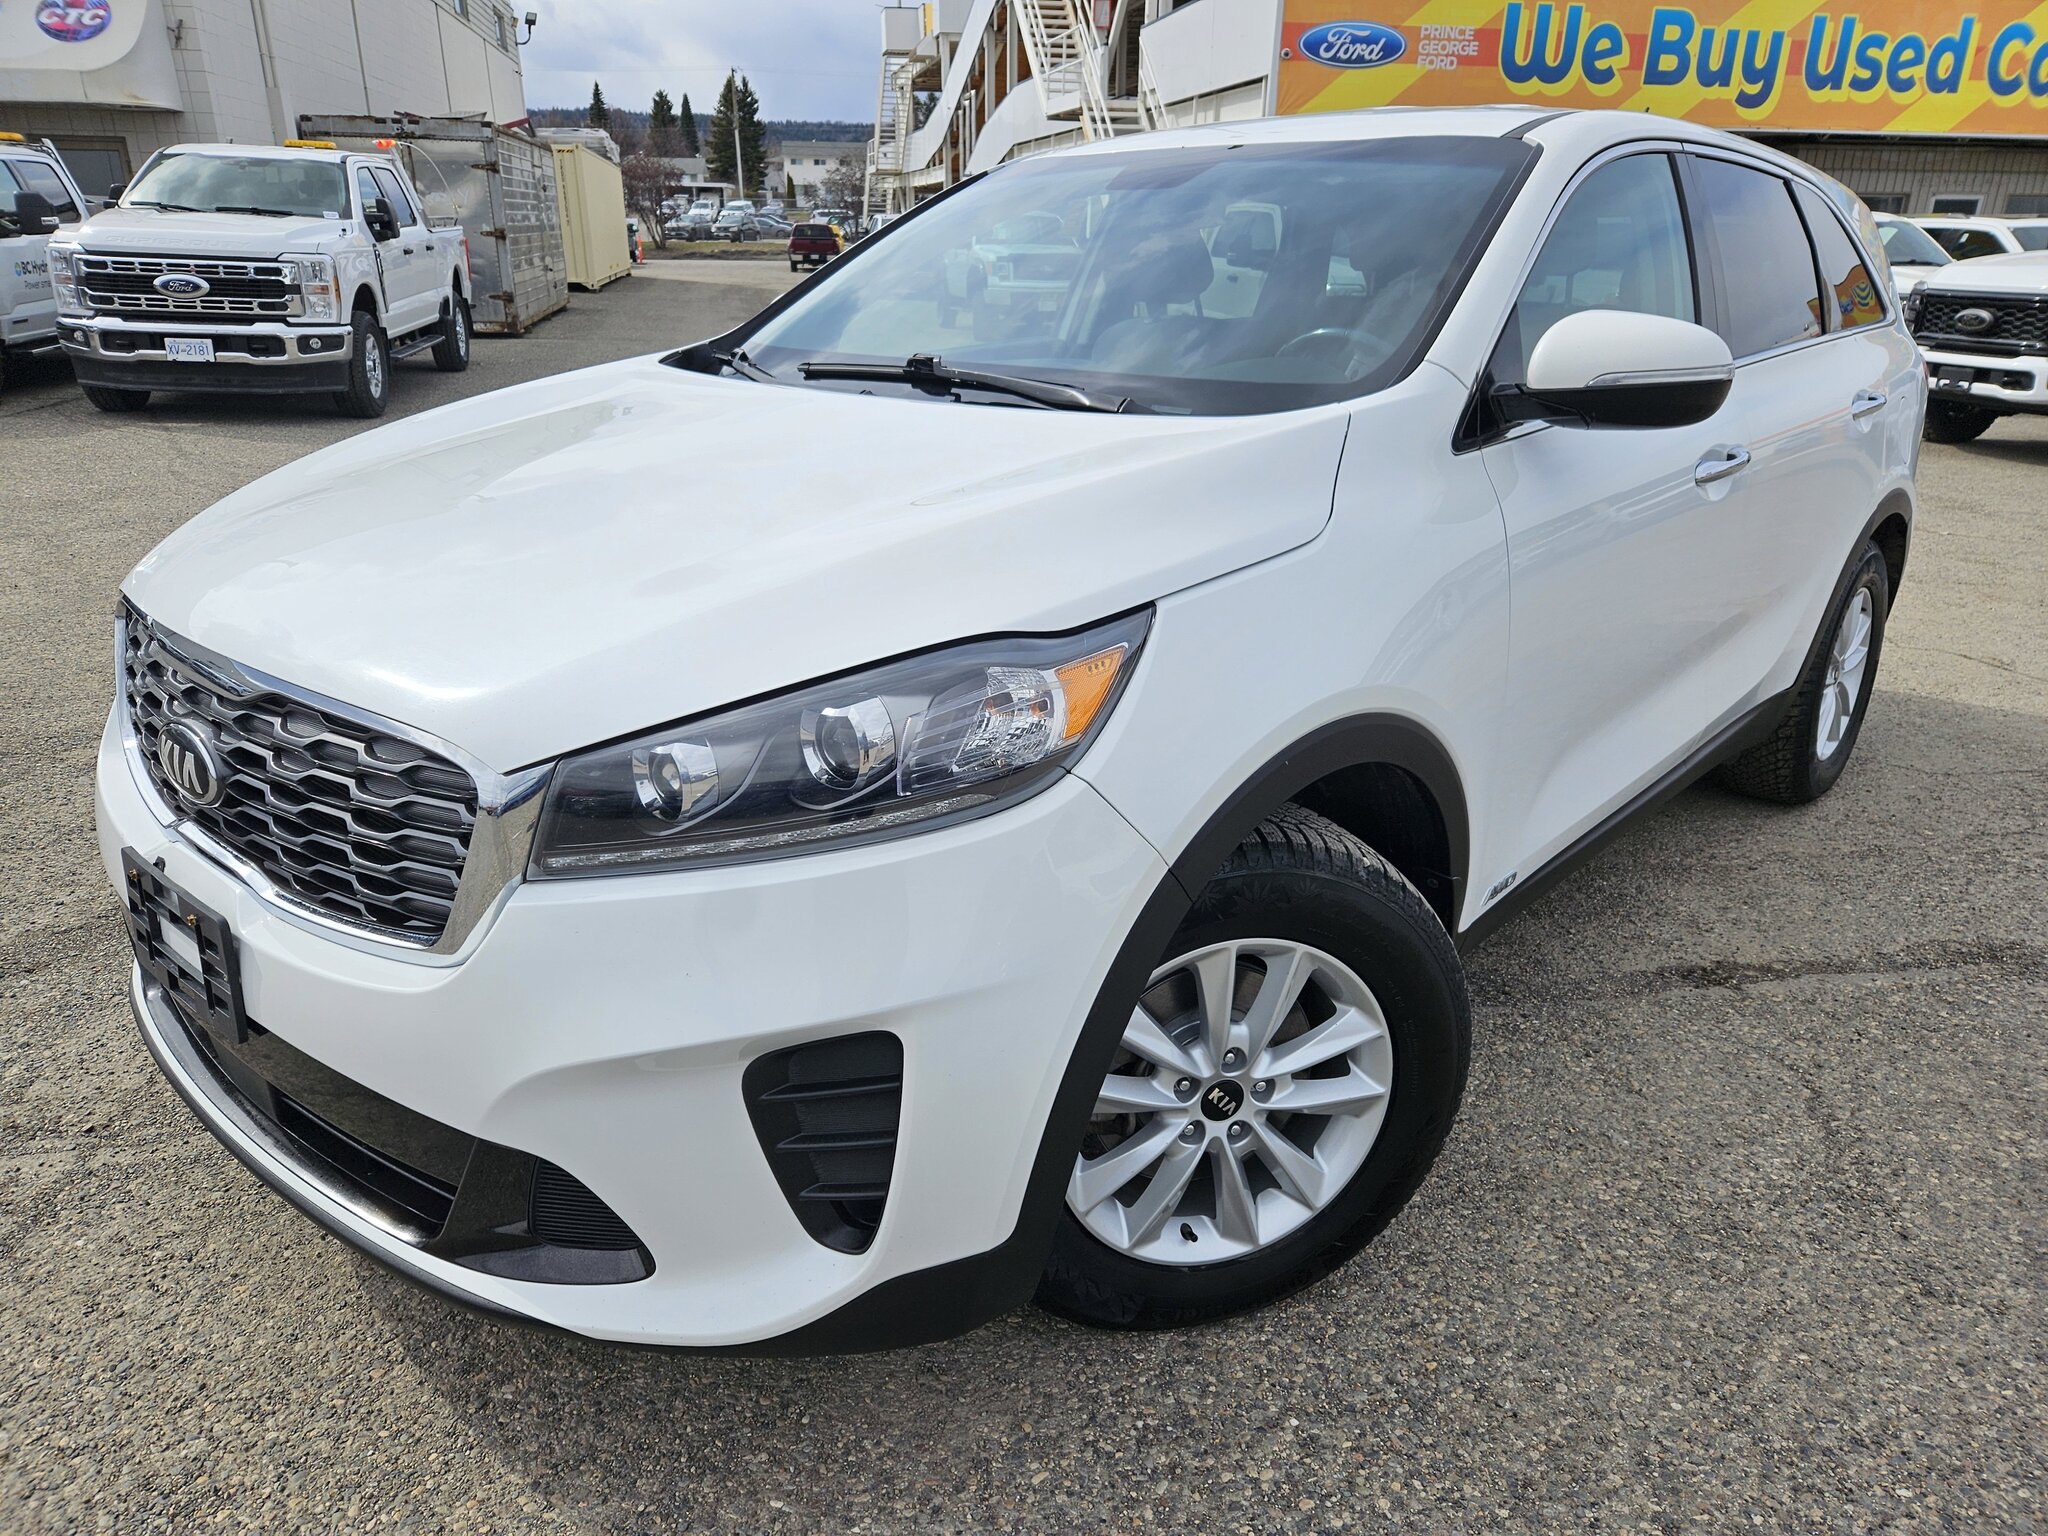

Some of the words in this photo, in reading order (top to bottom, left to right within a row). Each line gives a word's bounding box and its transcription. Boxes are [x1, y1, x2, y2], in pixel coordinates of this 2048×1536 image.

[39, 7, 106, 26] CTC
[1420, 24, 1475, 40] PRINCE
[1319, 27, 1387, 61] Ford
[1418, 40, 1480, 56] GEORGE
[1416, 56, 1458, 71] FORD
[1500, 2, 1623, 85] We
[1642, 9, 1786, 109] Buy
[1804, 15, 1977, 94] Used
[21, 261, 31, 275] BC
[167, 280, 194, 292] Ford
[160, 734, 203, 795] KIA
[1207, 1087, 1237, 1116] KIA
